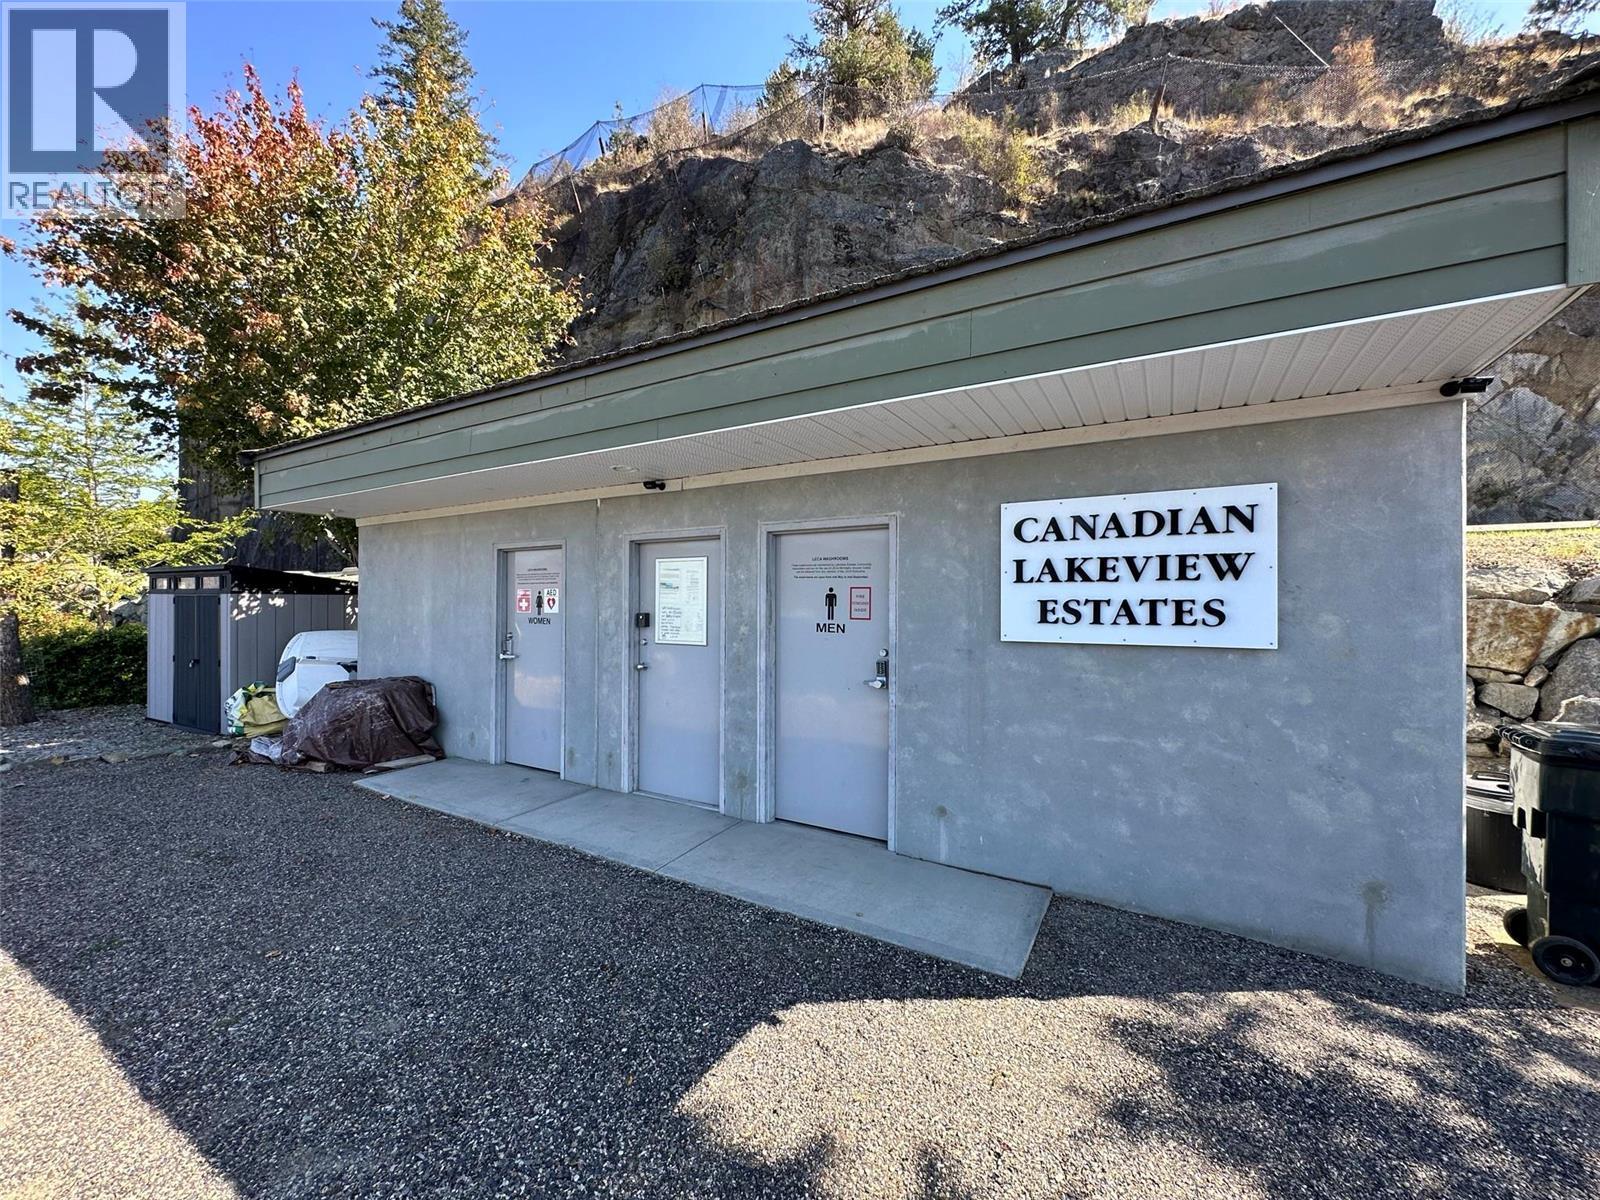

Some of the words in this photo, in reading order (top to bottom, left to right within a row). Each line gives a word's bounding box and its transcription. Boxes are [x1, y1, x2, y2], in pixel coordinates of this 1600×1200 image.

[1013, 504, 1259, 544] CANADIAN
[1012, 552, 1256, 584] LAKEVIEW
[547, 589, 557, 597] AED
[528, 617, 551, 625] WOMEN
[1037, 598, 1227, 628] ESTATES
[816, 623, 846, 634] MEN
